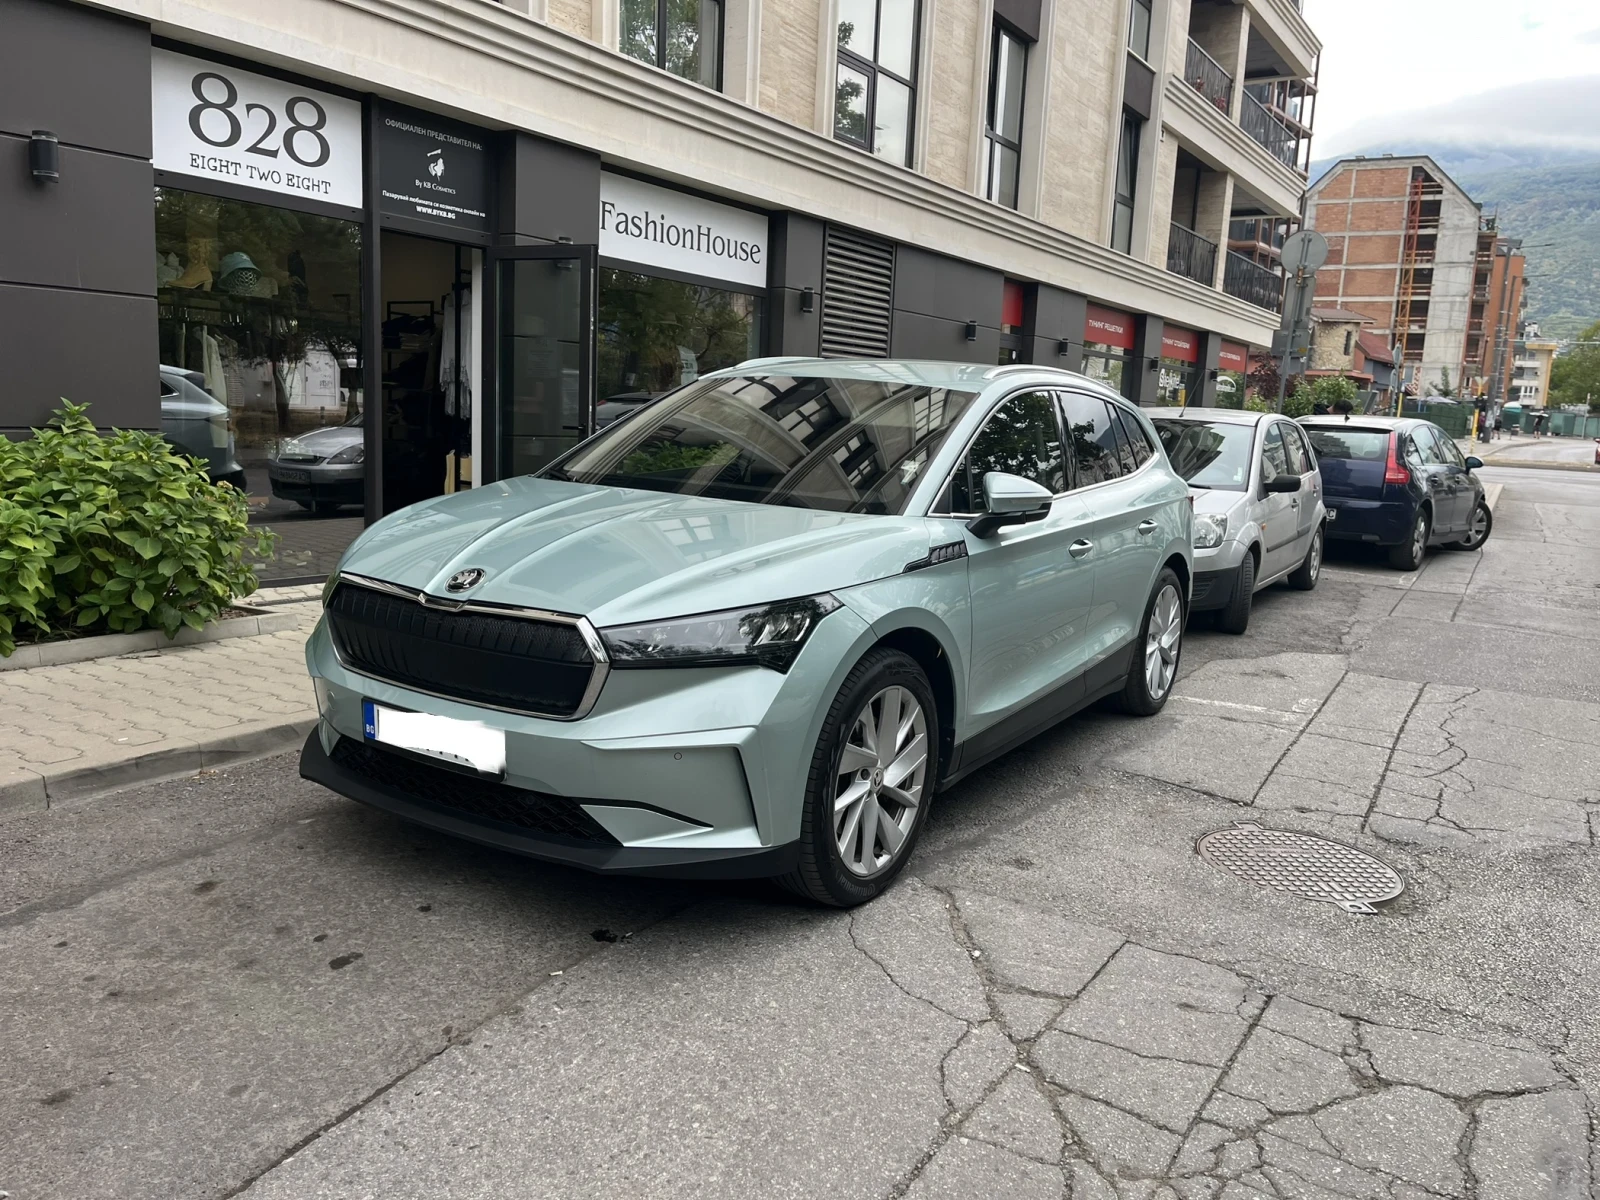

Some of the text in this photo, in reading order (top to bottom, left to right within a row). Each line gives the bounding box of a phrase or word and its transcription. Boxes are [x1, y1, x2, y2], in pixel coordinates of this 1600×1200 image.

[188, 72, 331, 168] 828
[384, 118, 427, 136] ОФИЦИАЛЕН
[427, 130, 472, 148] ПРЕДСТАВИТЕЛ
[189, 152, 331, 195] EIGHT TWO EIGHT
[415, 179, 423, 189] By
[423, 181, 432, 189] KB
[382, 190, 409, 201] Пазарувай
[600, 200, 761, 265] FashionHouse
[365, 723, 375, 734] BG
